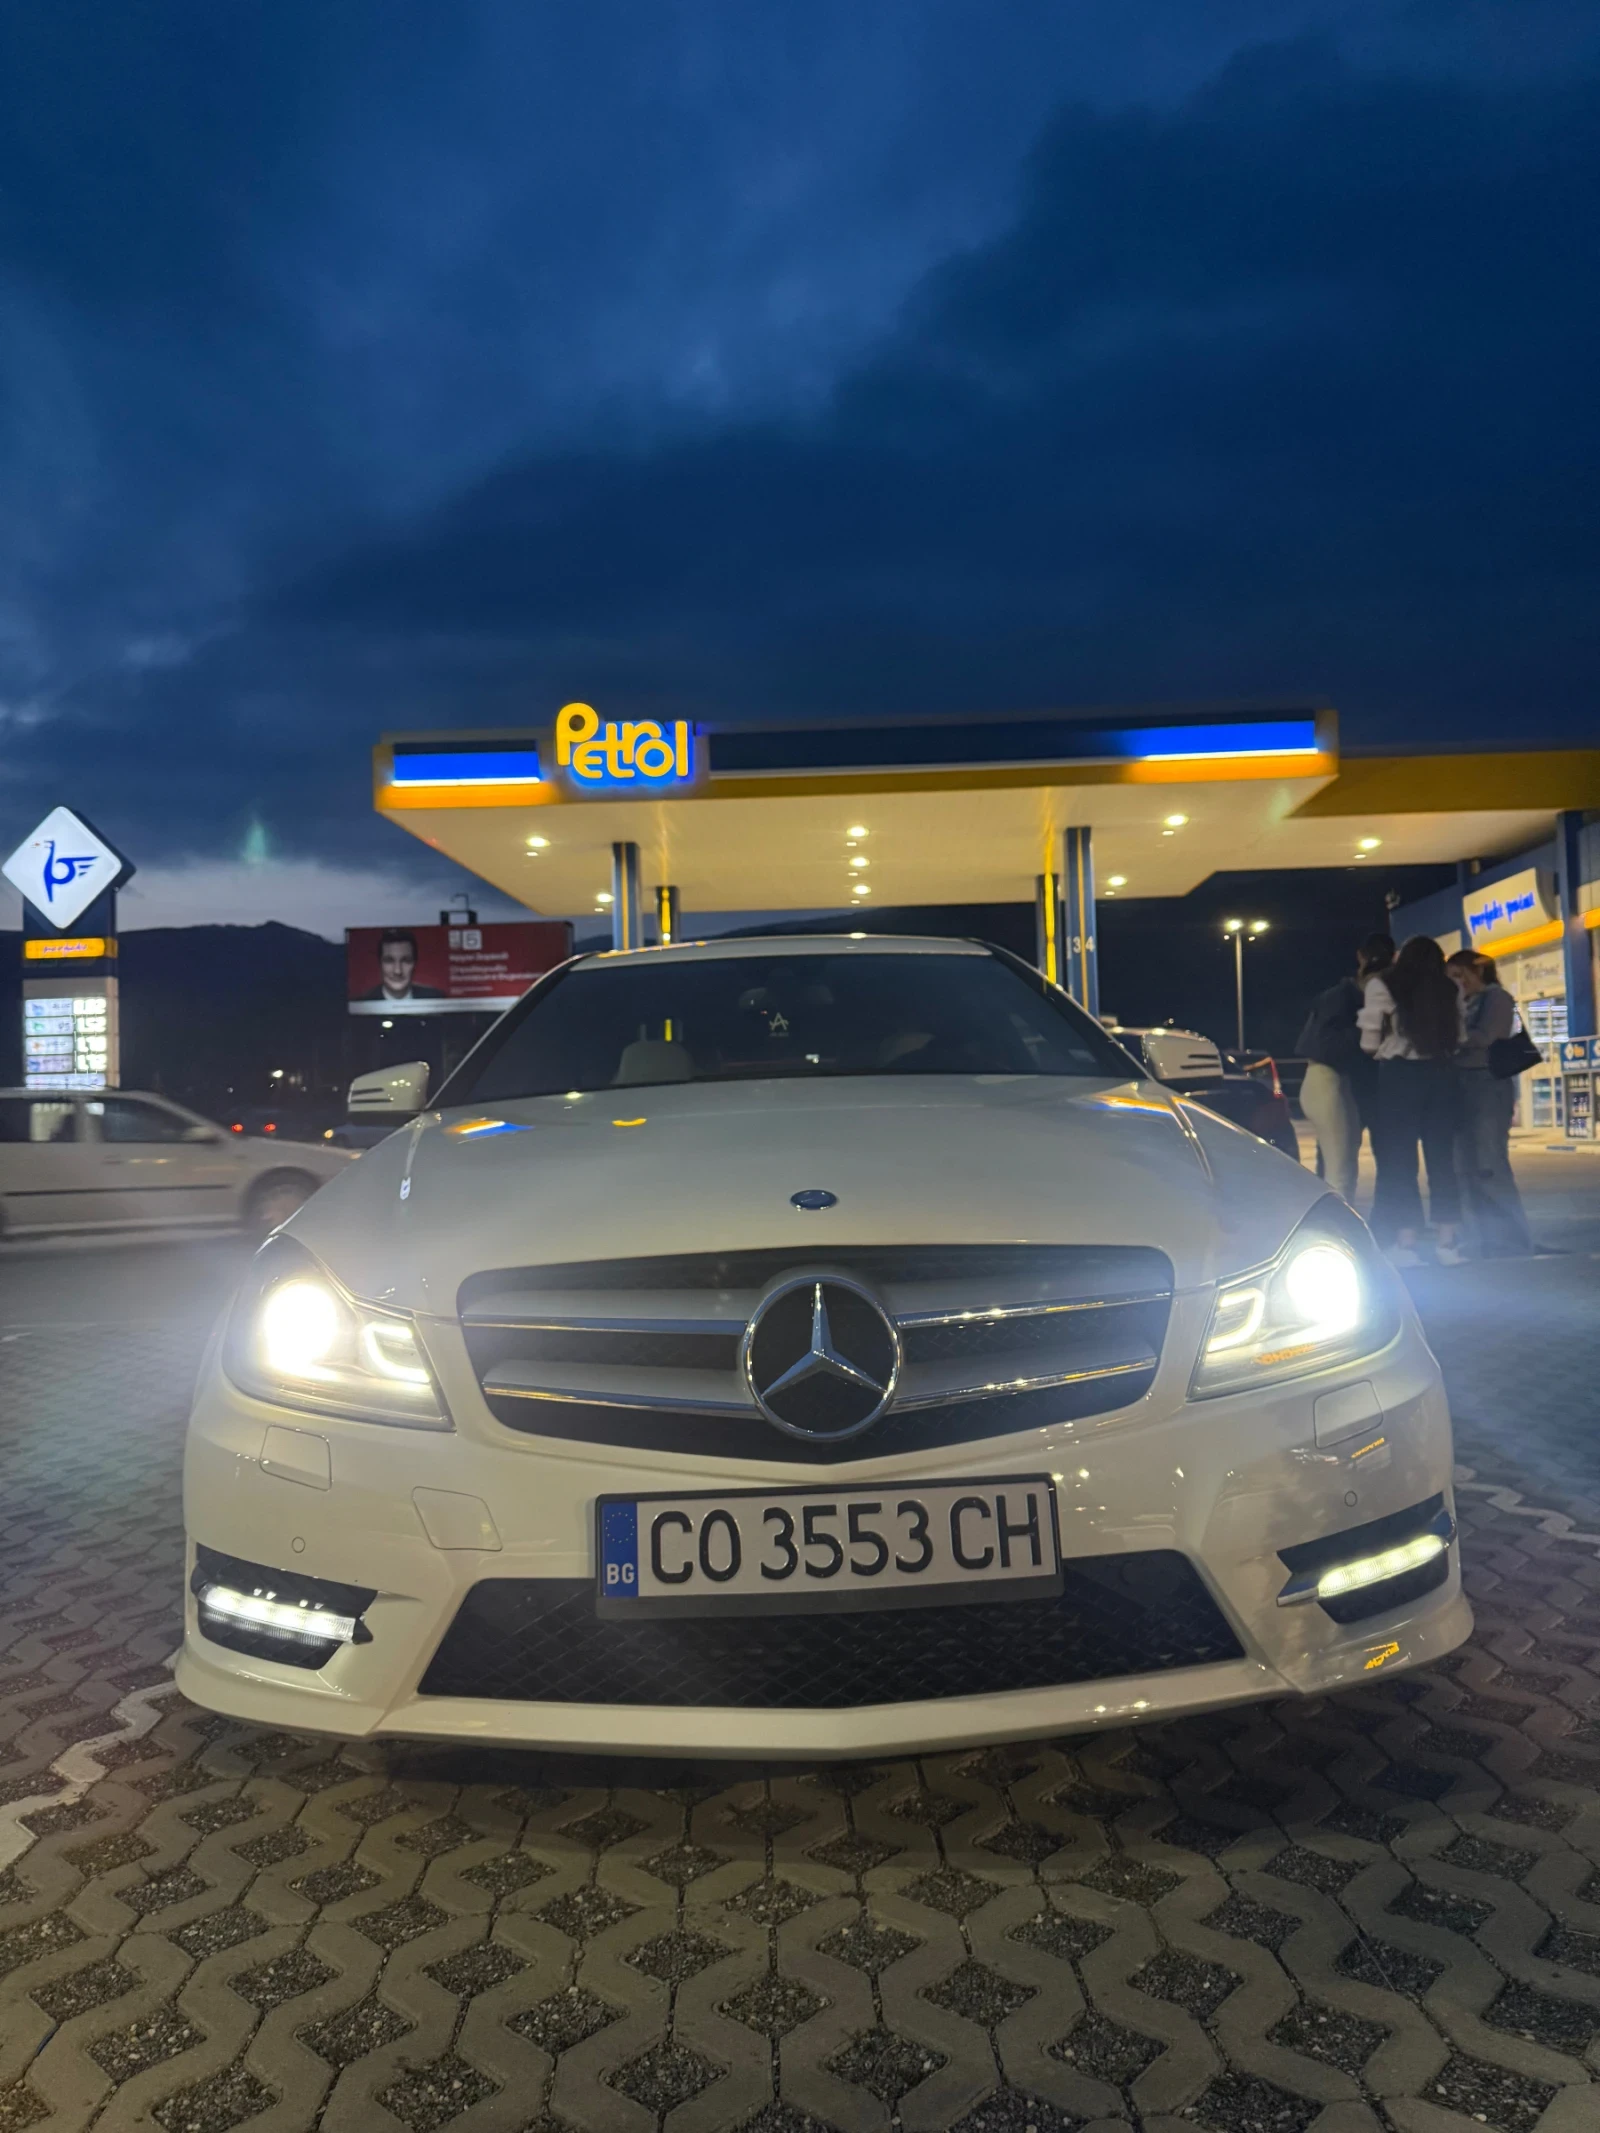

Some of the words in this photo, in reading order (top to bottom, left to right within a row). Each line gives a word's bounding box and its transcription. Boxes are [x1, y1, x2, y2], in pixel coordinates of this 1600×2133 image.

[556, 702, 689, 779] Petrol
[1073, 936, 1082, 954] 3
[1085, 935, 1096, 953] 4
[651, 1509, 742, 1584] CO
[760, 1500, 934, 1580] 3553
[949, 1492, 1043, 1570] CH
[606, 1563, 635, 1585] BG
